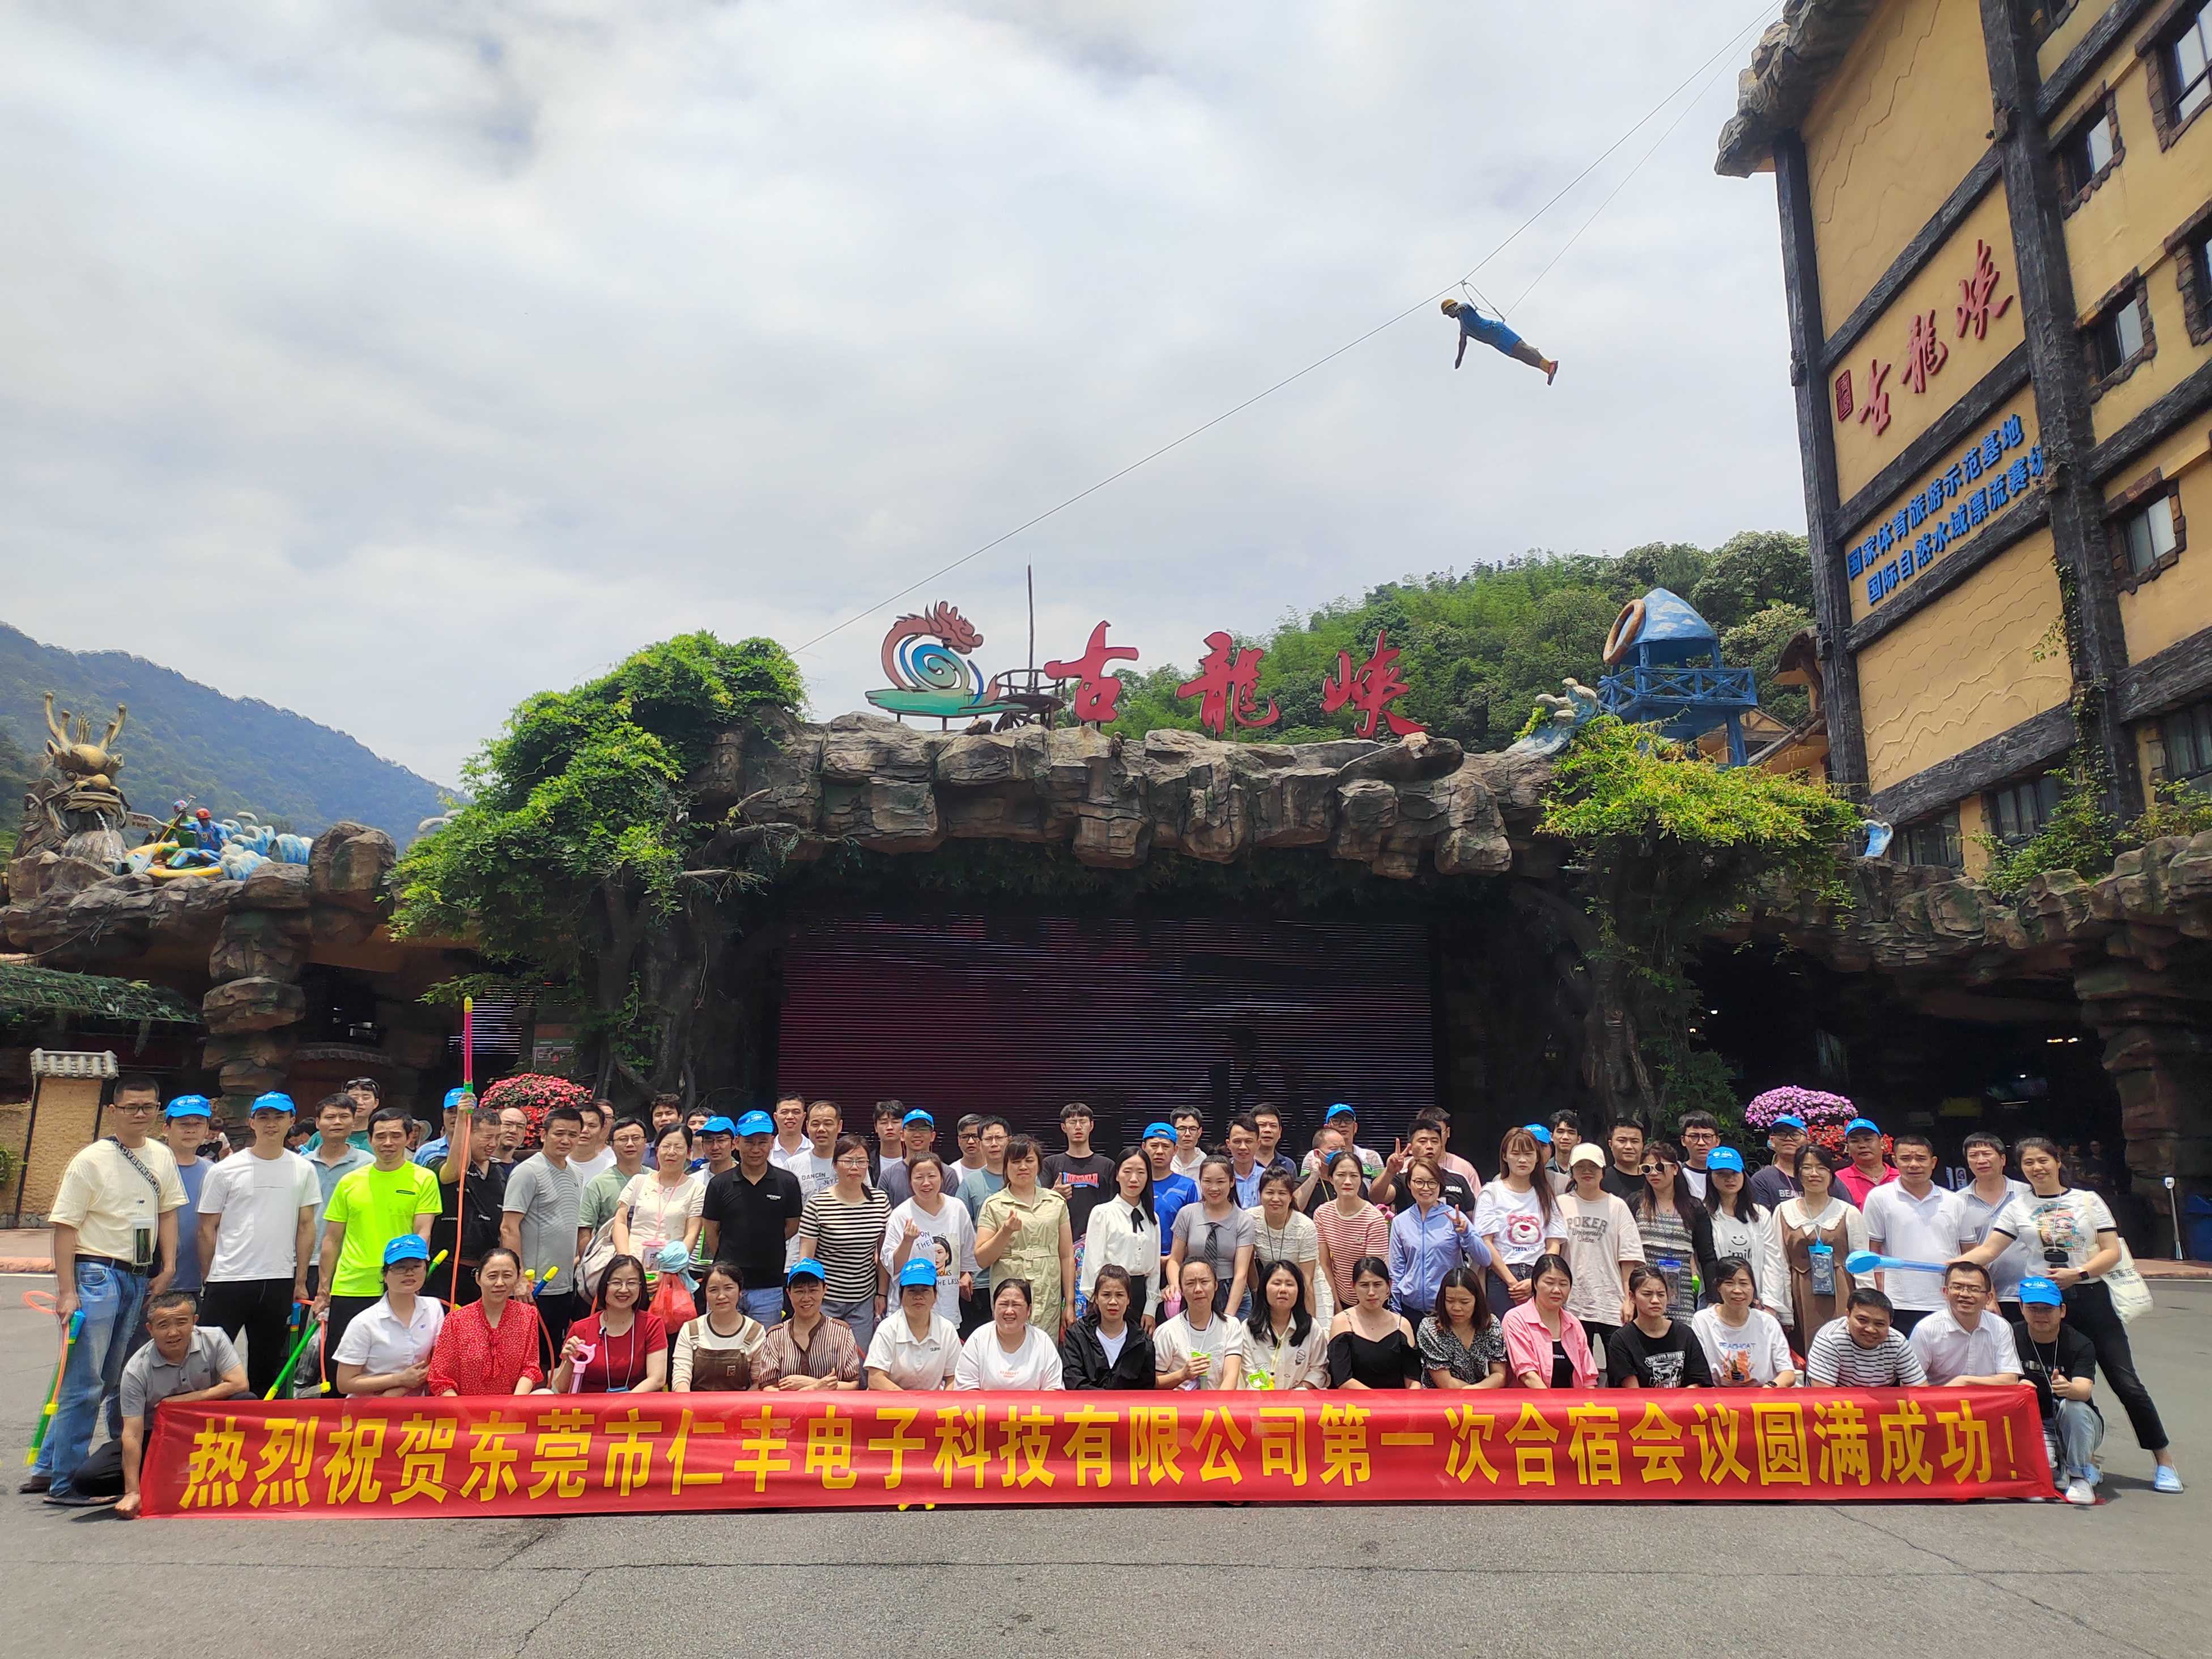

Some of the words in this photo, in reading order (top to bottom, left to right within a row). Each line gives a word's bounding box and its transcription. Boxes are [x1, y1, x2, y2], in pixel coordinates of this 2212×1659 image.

[1847, 414, 2024, 580] 国家体育旅游示范基地
[1566, 1216, 1607, 1233] POKER
